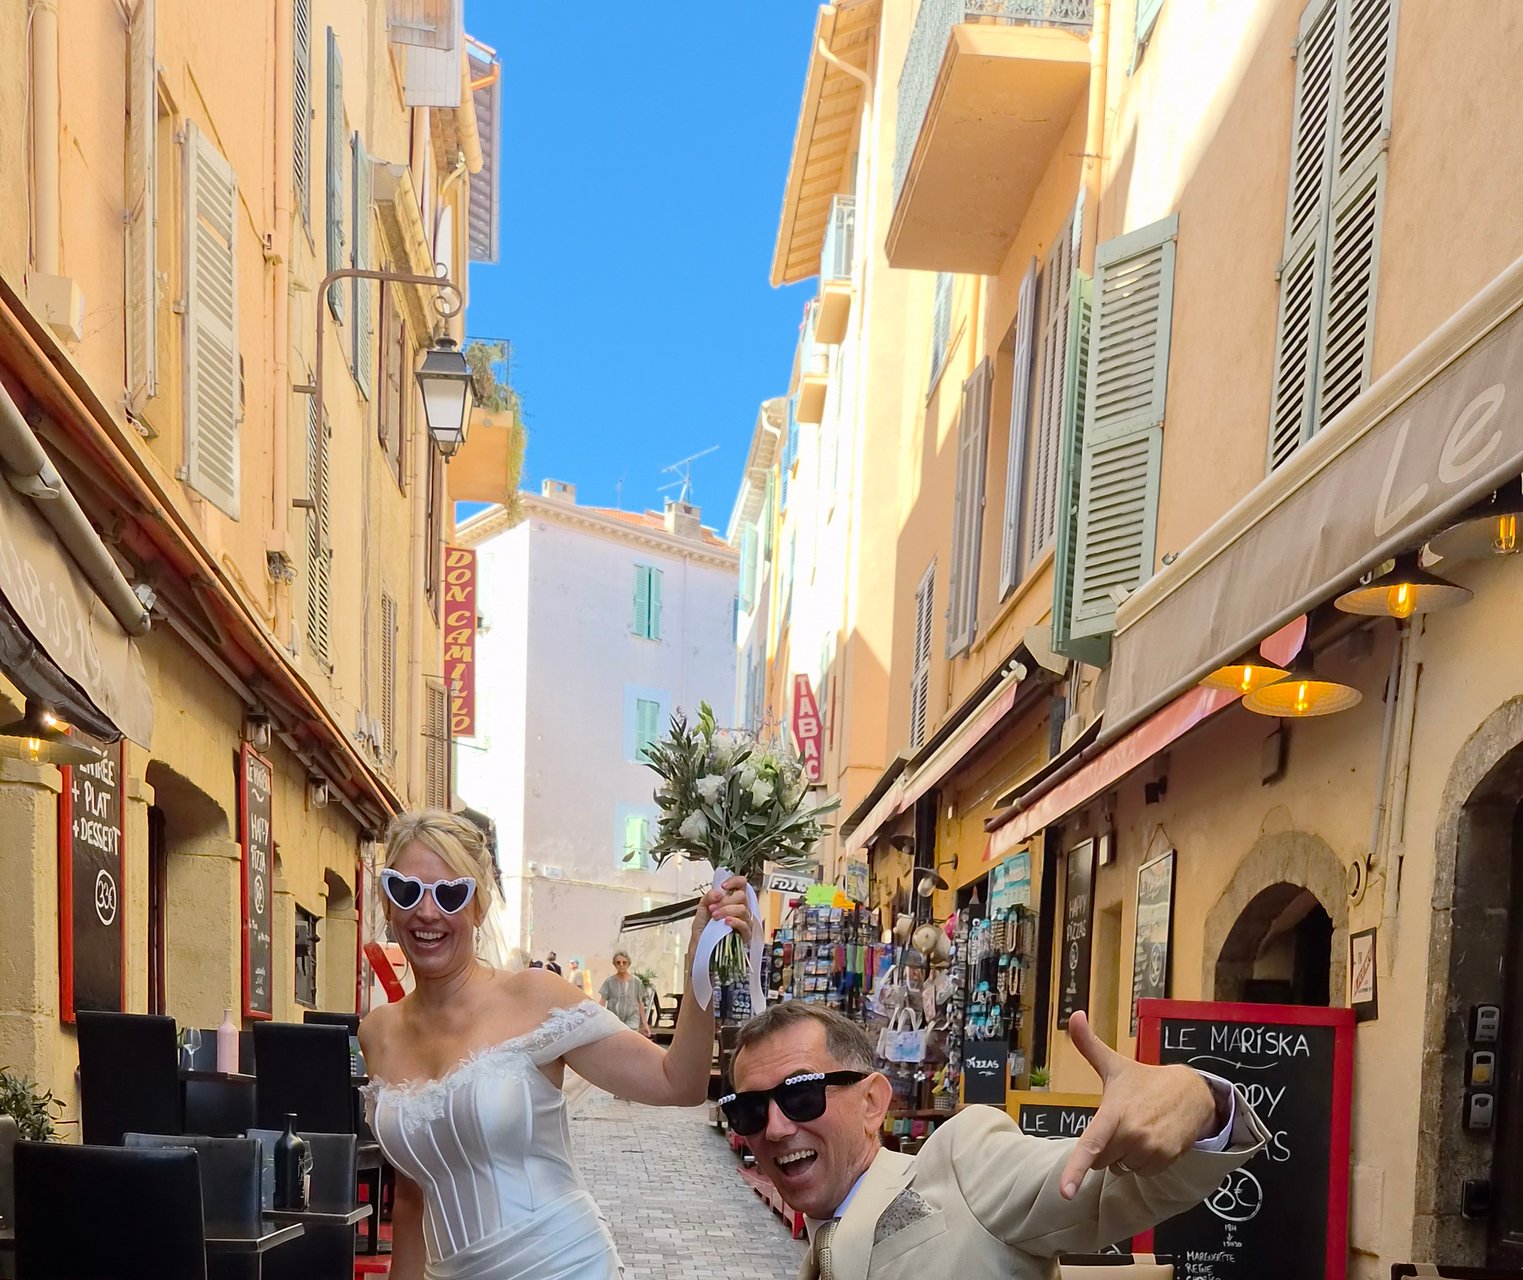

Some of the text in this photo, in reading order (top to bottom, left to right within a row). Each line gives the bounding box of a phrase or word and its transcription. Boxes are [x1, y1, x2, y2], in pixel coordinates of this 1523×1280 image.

[1374, 382, 1506, 537] Le
[444, 550, 473, 731] DON CAMILLO
[797, 675, 819, 780] TABAC
[84, 780, 111, 819] PLAT
[771, 877, 798, 892] FDJ
[1164, 1025, 1196, 1050] LE
[1022, 1112, 1048, 1132] LE
